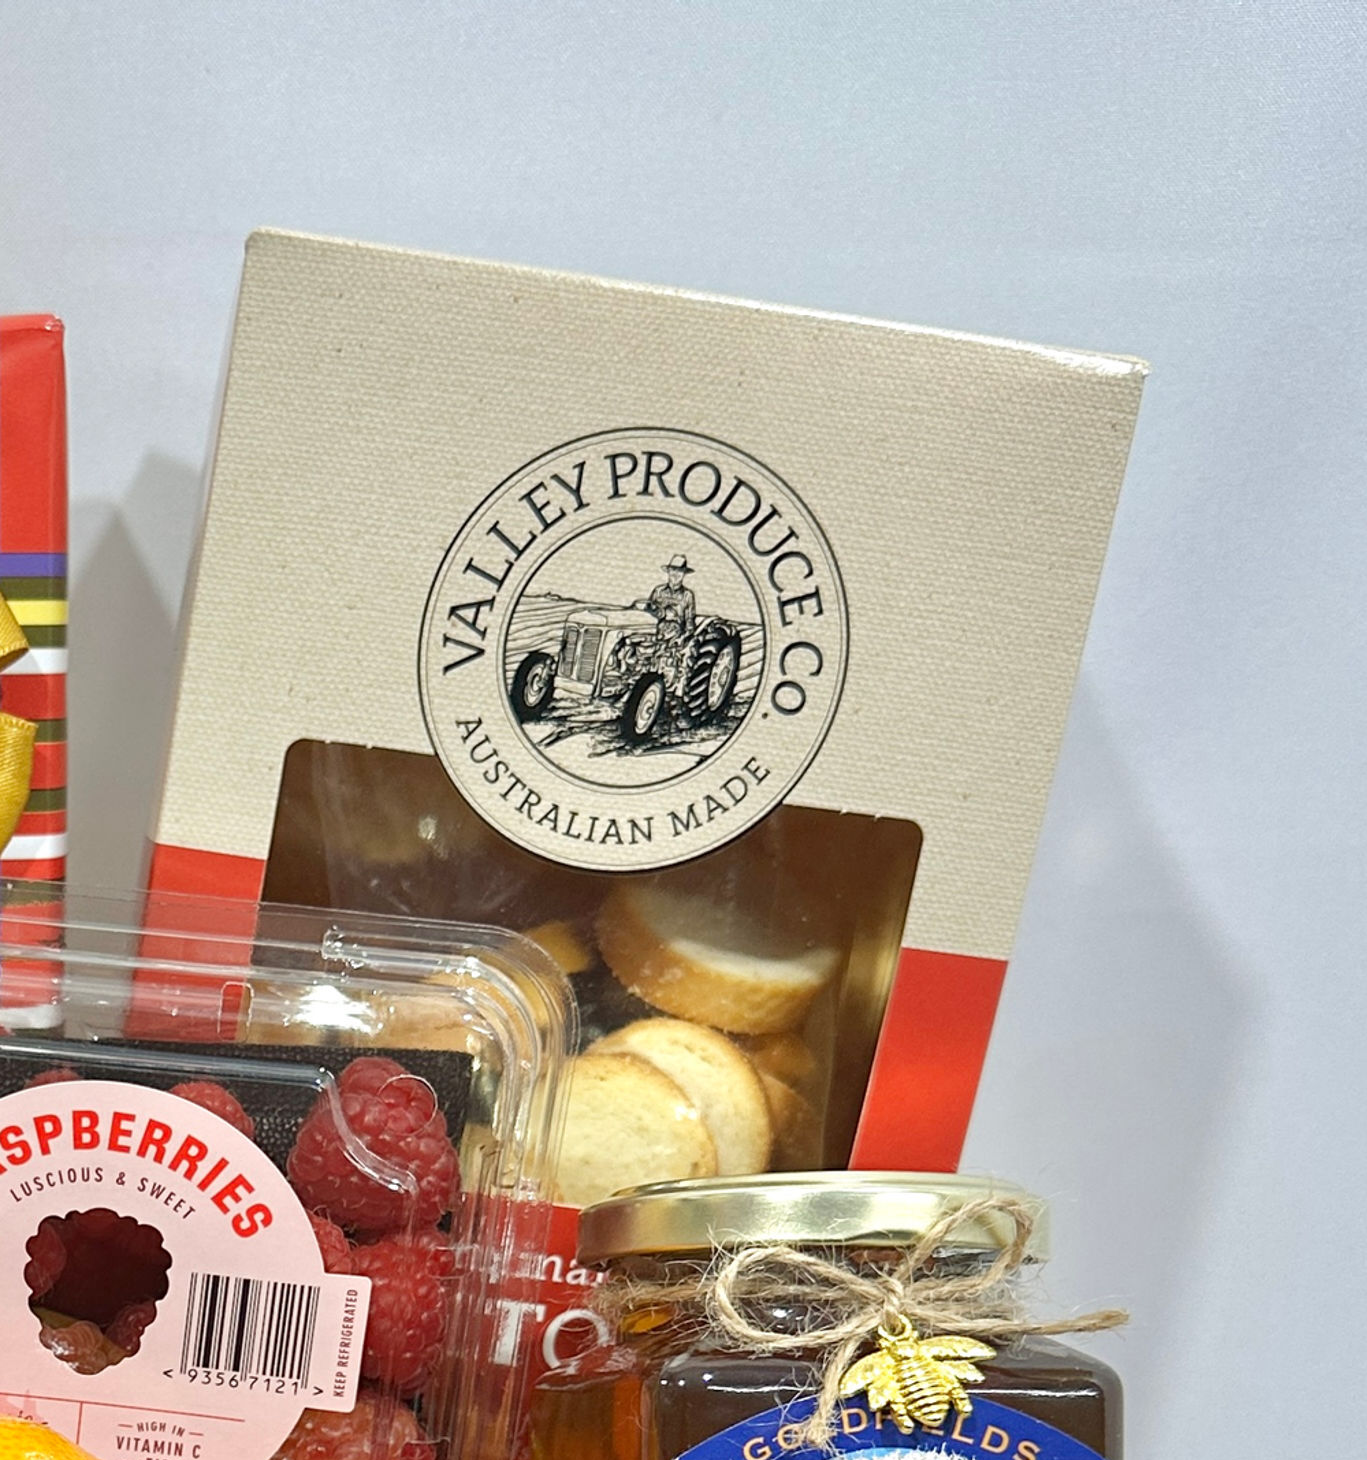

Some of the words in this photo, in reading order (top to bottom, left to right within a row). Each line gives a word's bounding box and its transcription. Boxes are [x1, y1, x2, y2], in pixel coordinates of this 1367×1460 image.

[442, 461, 590, 676] VALLEY
[604, 451, 823, 627] PRODUCE
[762, 641, 823, 720] CO.
[456, 717, 653, 846] AUSTRALIAN
[668, 757, 771, 838] MADE
[8, 1167, 103, 1203] LUSCIOUS
[117, 1172, 126, 1186] &
[137, 1176, 196, 1221] SWEET
[337, 1289, 359, 1368] REFRIGERATED
[333, 1372, 345, 1397] KEEP
[116, 1435, 184, 1457] VITAMIN
[192, 1444, 201, 1459] C
[137, 1421, 167, 1433] HIGH
[172, 1425, 186, 1437] IN
